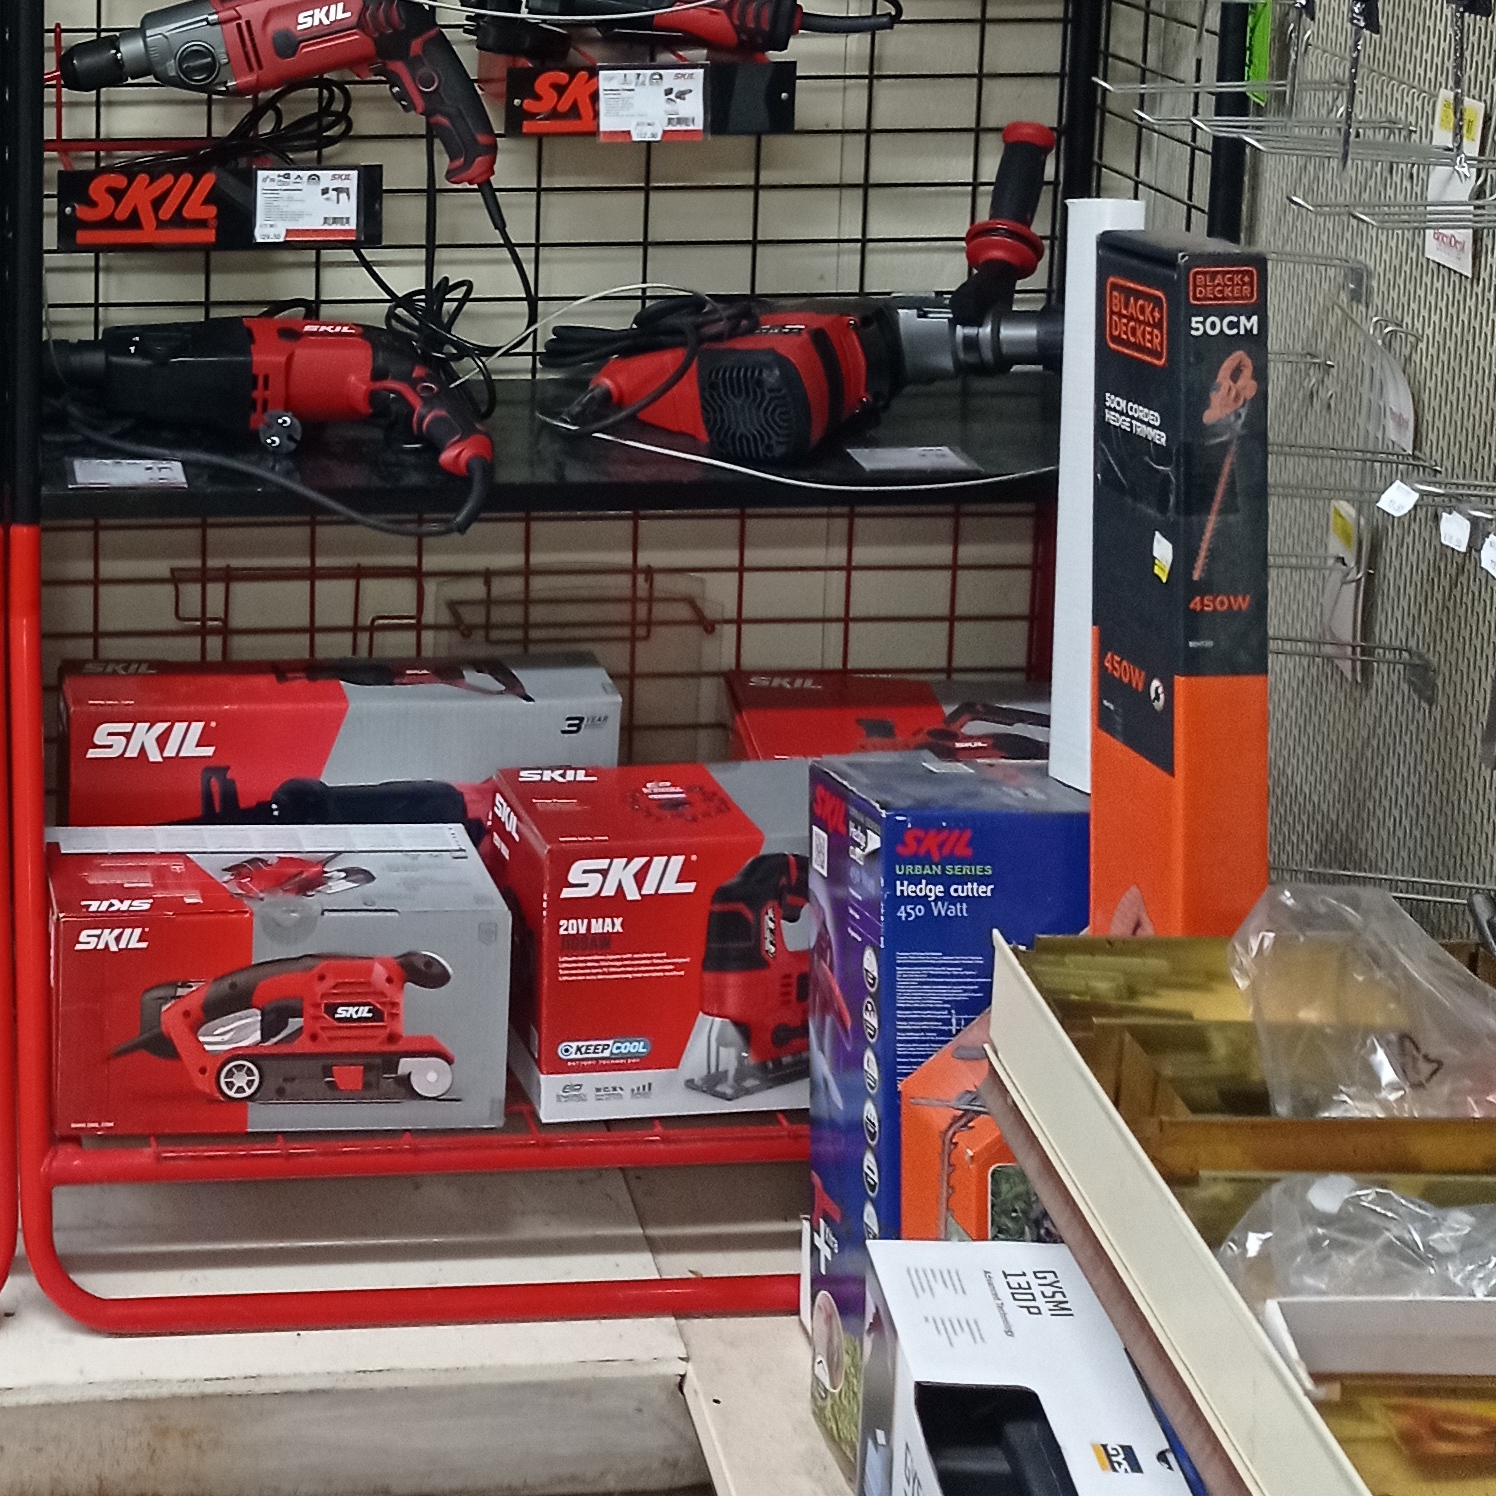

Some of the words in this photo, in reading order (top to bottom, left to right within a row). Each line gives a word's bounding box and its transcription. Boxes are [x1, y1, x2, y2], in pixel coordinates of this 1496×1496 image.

[297, 1, 352, 30] SKIL
[673, 72, 695, 80] SKIL
[522, 71, 599, 122] SK
[330, 173, 351, 181] SKIL
[76, 173, 217, 231] SKIL
[1196, 273, 1251, 286] BLACK+
[1196, 285, 1251, 298] DECKER
[1112, 290, 1161, 323] BLACK+
[1112, 314, 1162, 353] DECKER
[1190, 315, 1259, 336] 50CM
[1105, 393, 1126, 412] 50CM
[1127, 400, 1160, 426] CORDED
[1105, 408, 1131, 430] HEDGE
[1131, 414, 1167, 446] TRIMMER
[1189, 595, 1251, 613] 450W
[1104, 652, 1145, 692] 450W
[560, 715, 584, 735] 3
[585, 714, 610, 724] YEAR
[86, 721, 216, 762] SKIL
[518, 769, 598, 783] SKIL
[494, 792, 519, 843] SKIL
[896, 828, 973, 862] SKIL
[560, 854, 697, 901] SKIL
[895, 864, 942, 875] URBAN
[945, 864, 992, 875] SERIES
[896, 880, 945, 901] Hedge
[949, 882, 994, 897] cutter
[81, 898, 154, 912] SKIL
[897, 905, 925, 921] 450
[931, 901, 968, 917] Watt
[559, 918, 587, 935] 20V
[591, 916, 623, 934] MAX
[74, 928, 149, 952] SKIL
[334, 1006, 373, 1019] SKIL
[1033, 1270, 1075, 1317] GYSMI
